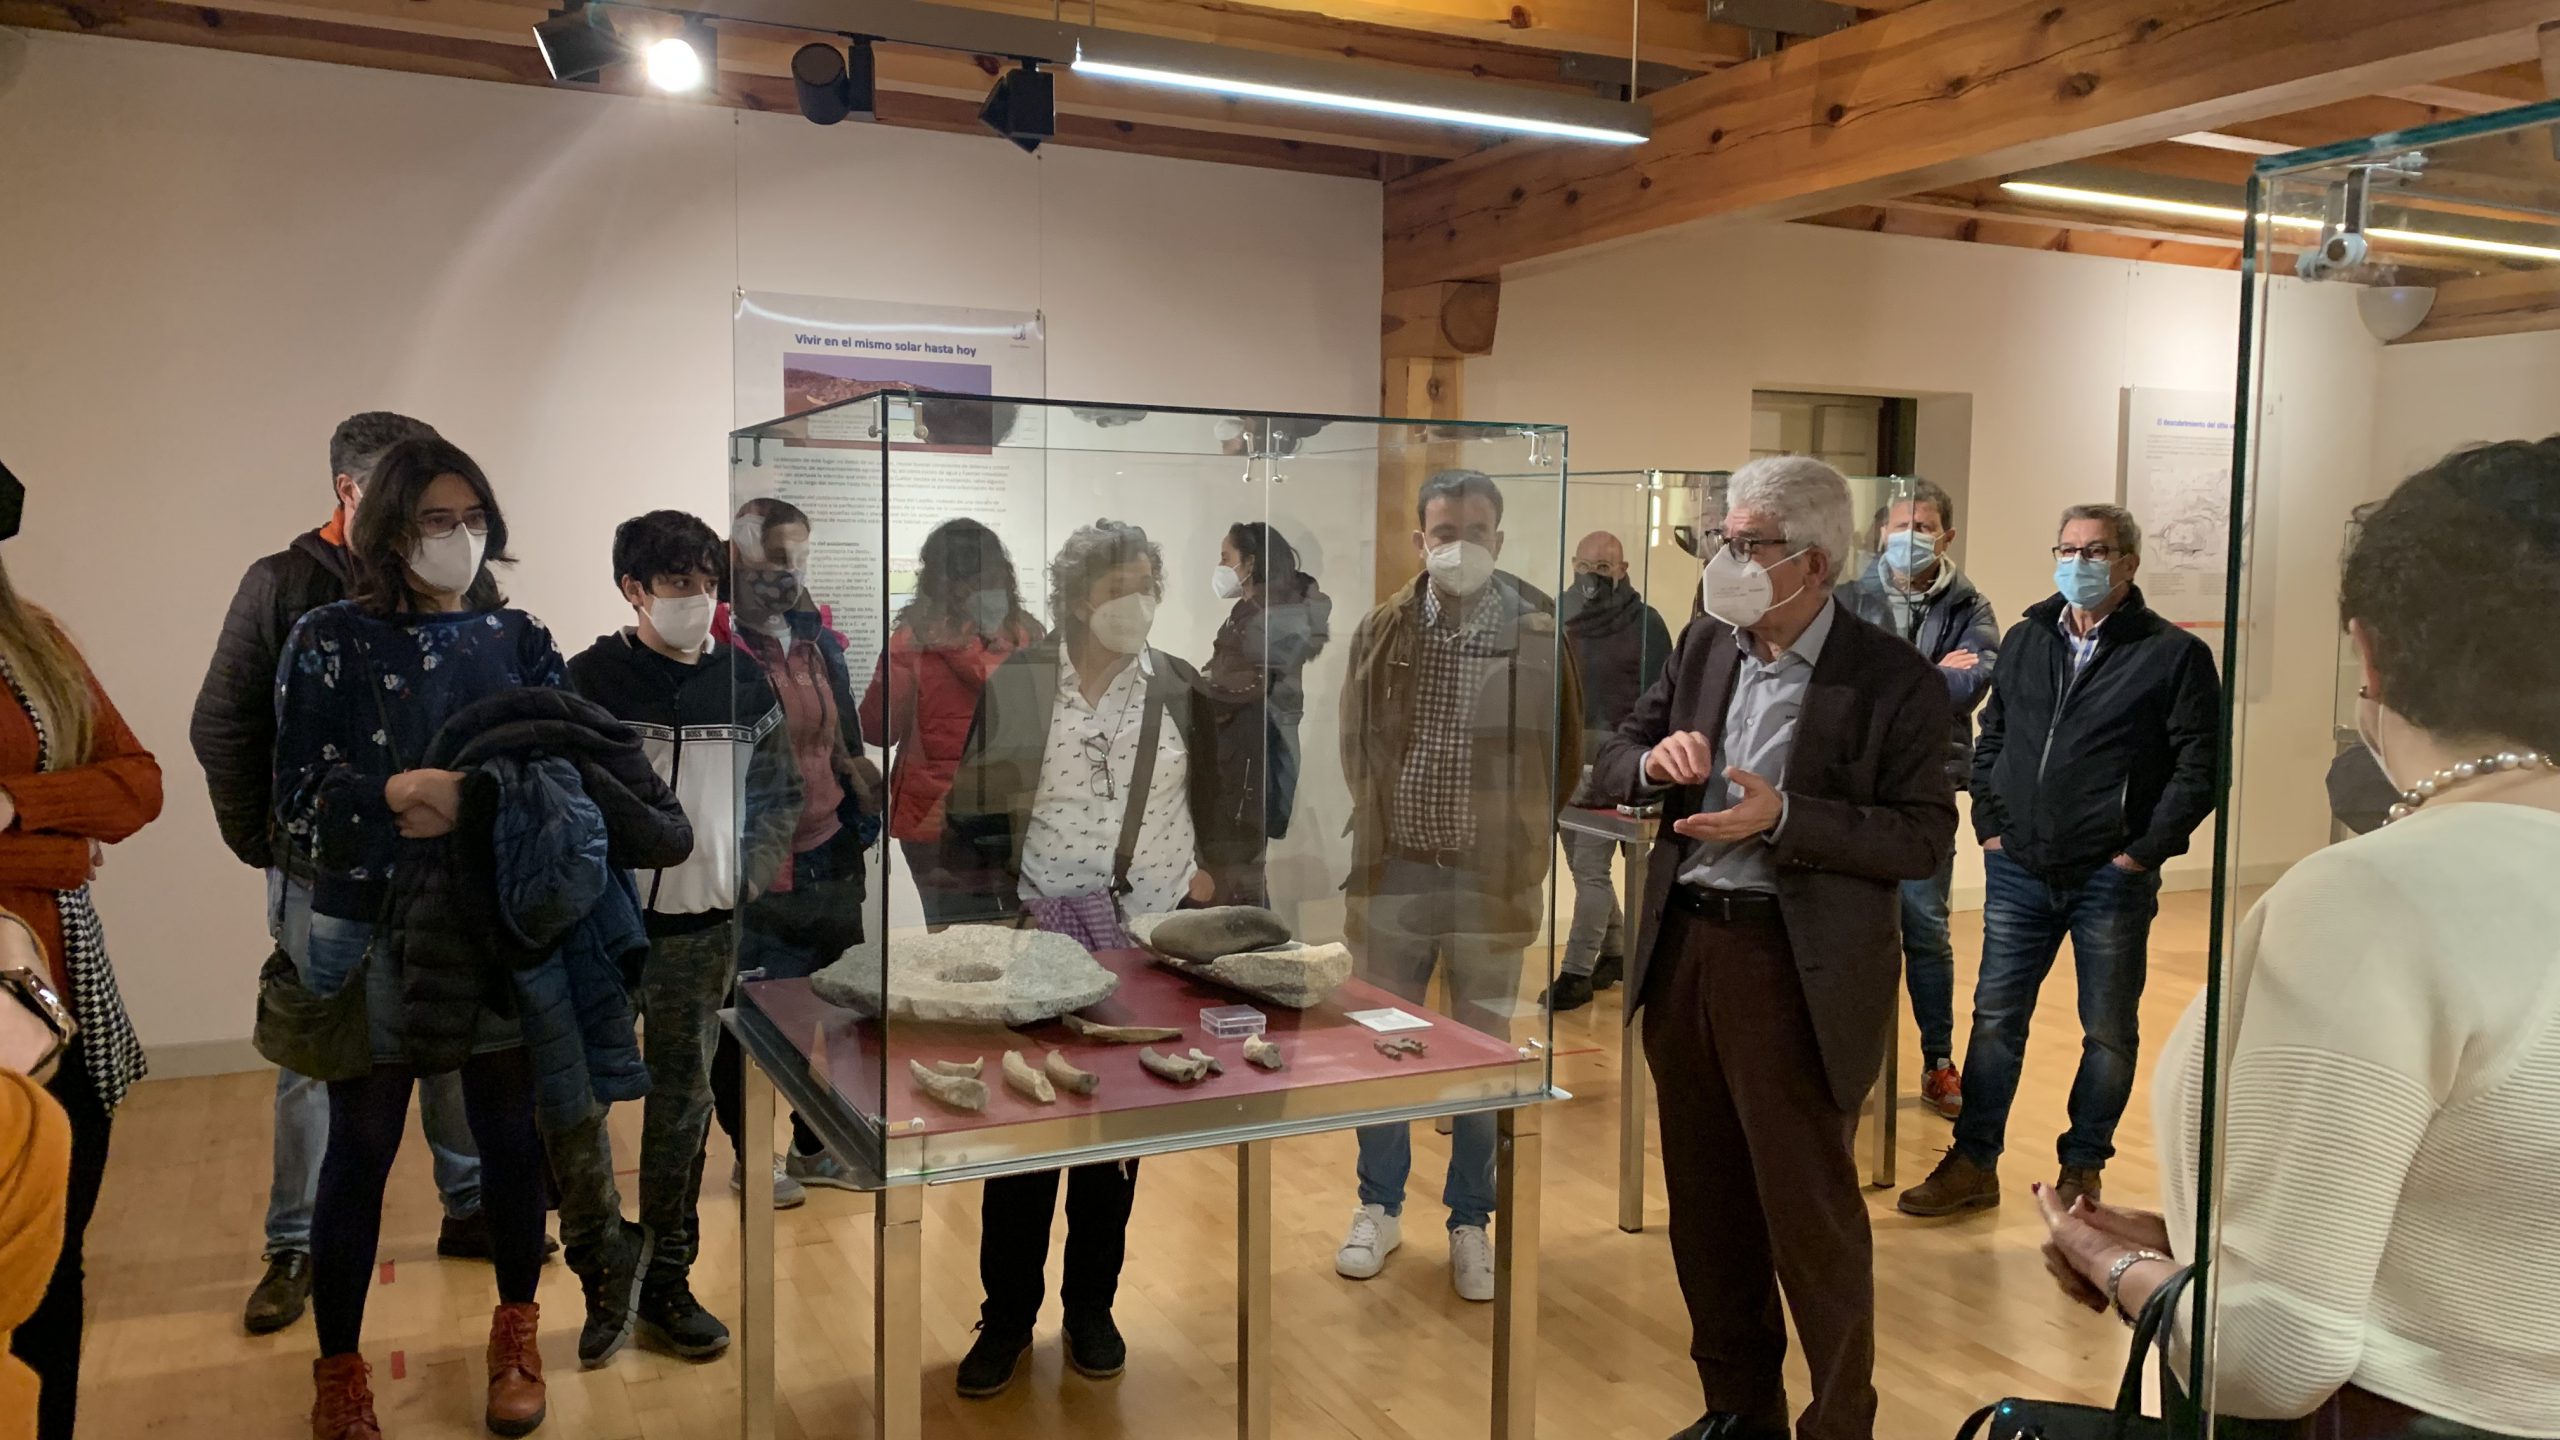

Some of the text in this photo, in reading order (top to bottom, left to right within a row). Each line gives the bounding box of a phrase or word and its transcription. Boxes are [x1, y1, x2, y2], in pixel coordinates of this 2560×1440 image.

[794, 333, 977, 358] Vivir en el mismo solar hasta hoy
